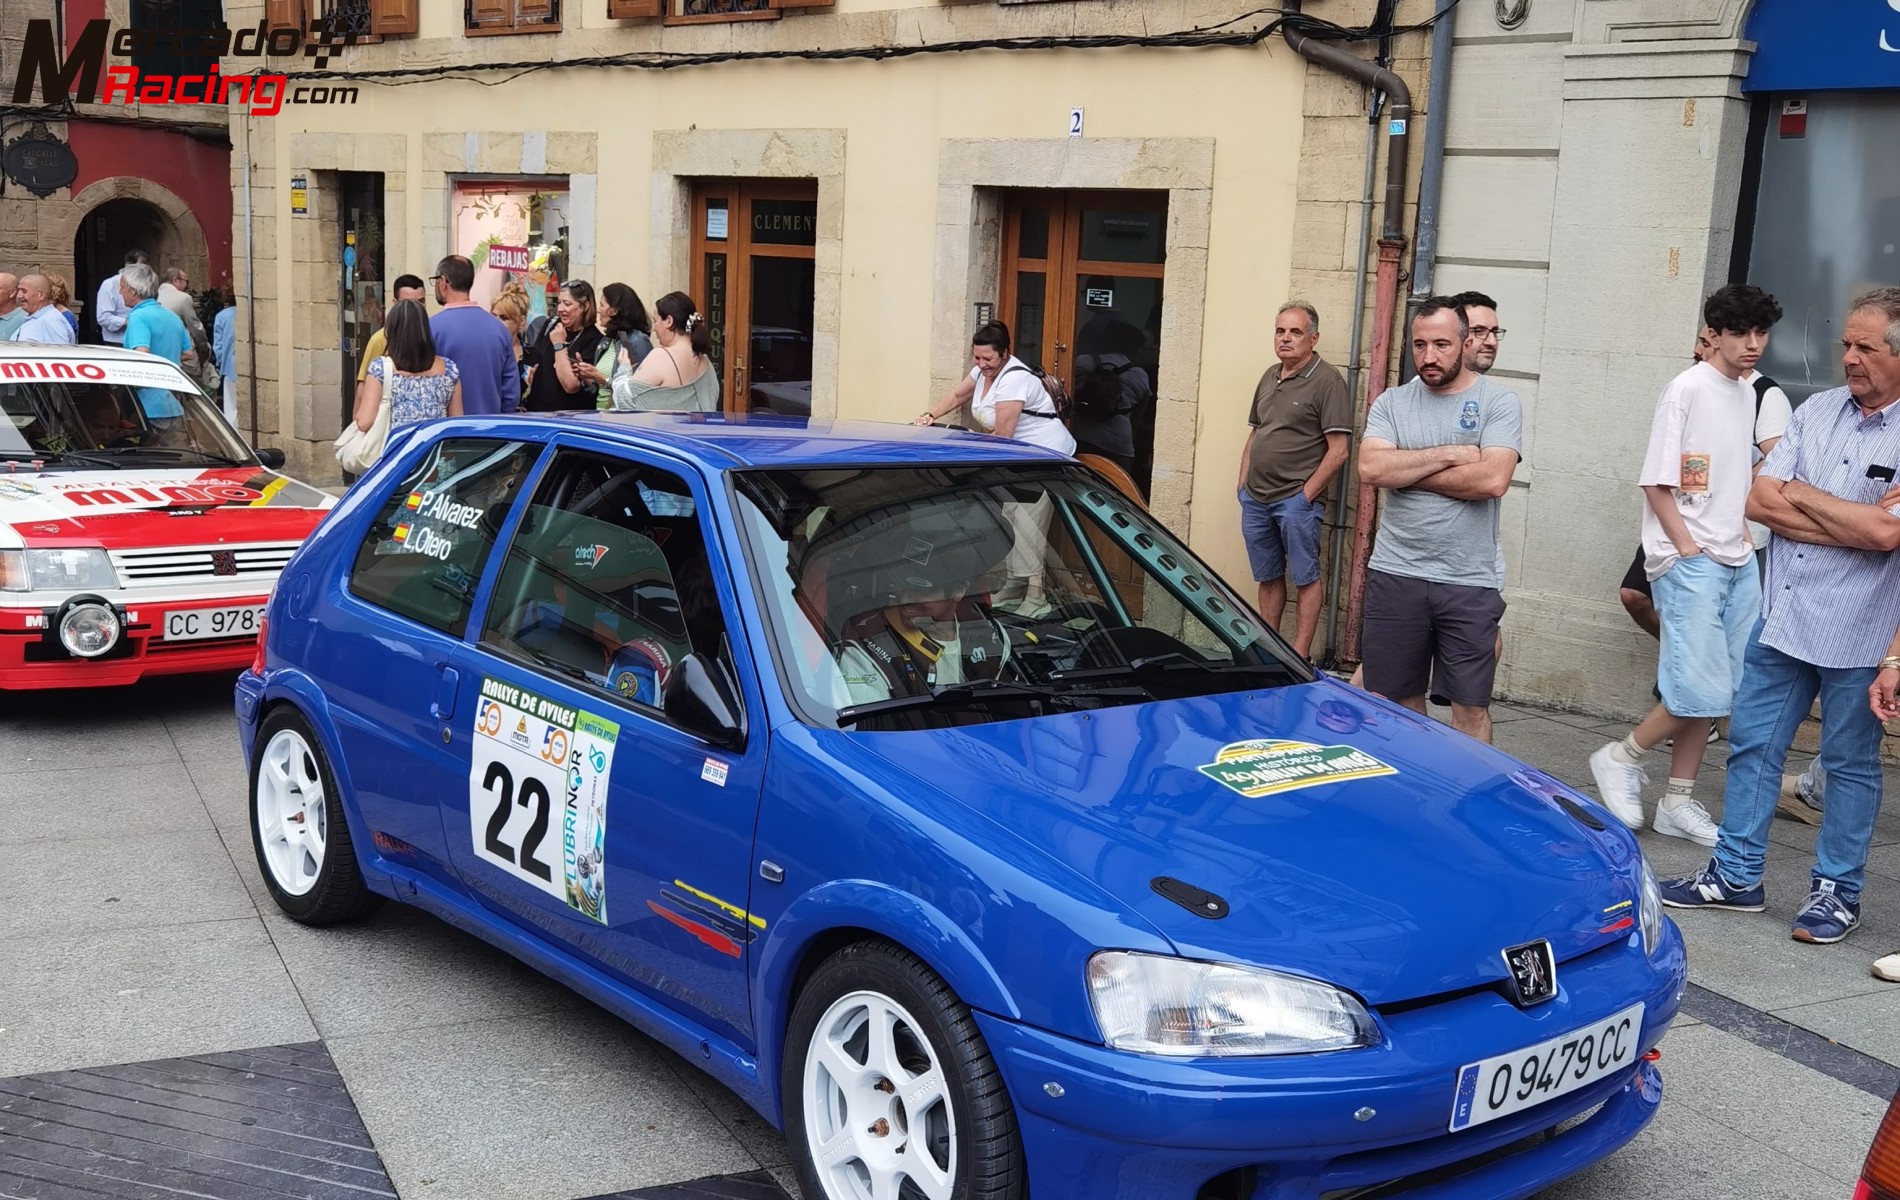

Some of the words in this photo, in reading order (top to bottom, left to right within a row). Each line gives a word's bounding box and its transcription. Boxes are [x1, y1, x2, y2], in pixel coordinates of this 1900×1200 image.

[1071, 111, 1081, 133] 2
[754, 214, 817, 231] CLEMEN
[490, 248, 528, 269] REBAJAS
[416, 490, 484, 530] P.Alvarez
[404, 523, 451, 560] L.Otero
[169, 614, 199, 636] CC
[482, 678, 520, 706] RALLYE
[519, 692, 538, 713] DE
[537, 700, 576, 728] AVILES
[482, 760, 552, 883] 22
[565, 749, 583, 881] LUBRINOR
[1516, 1034, 1595, 1101] 9479
[1597, 1018, 1631, 1070] CC
[1459, 1102, 1468, 1117] E
